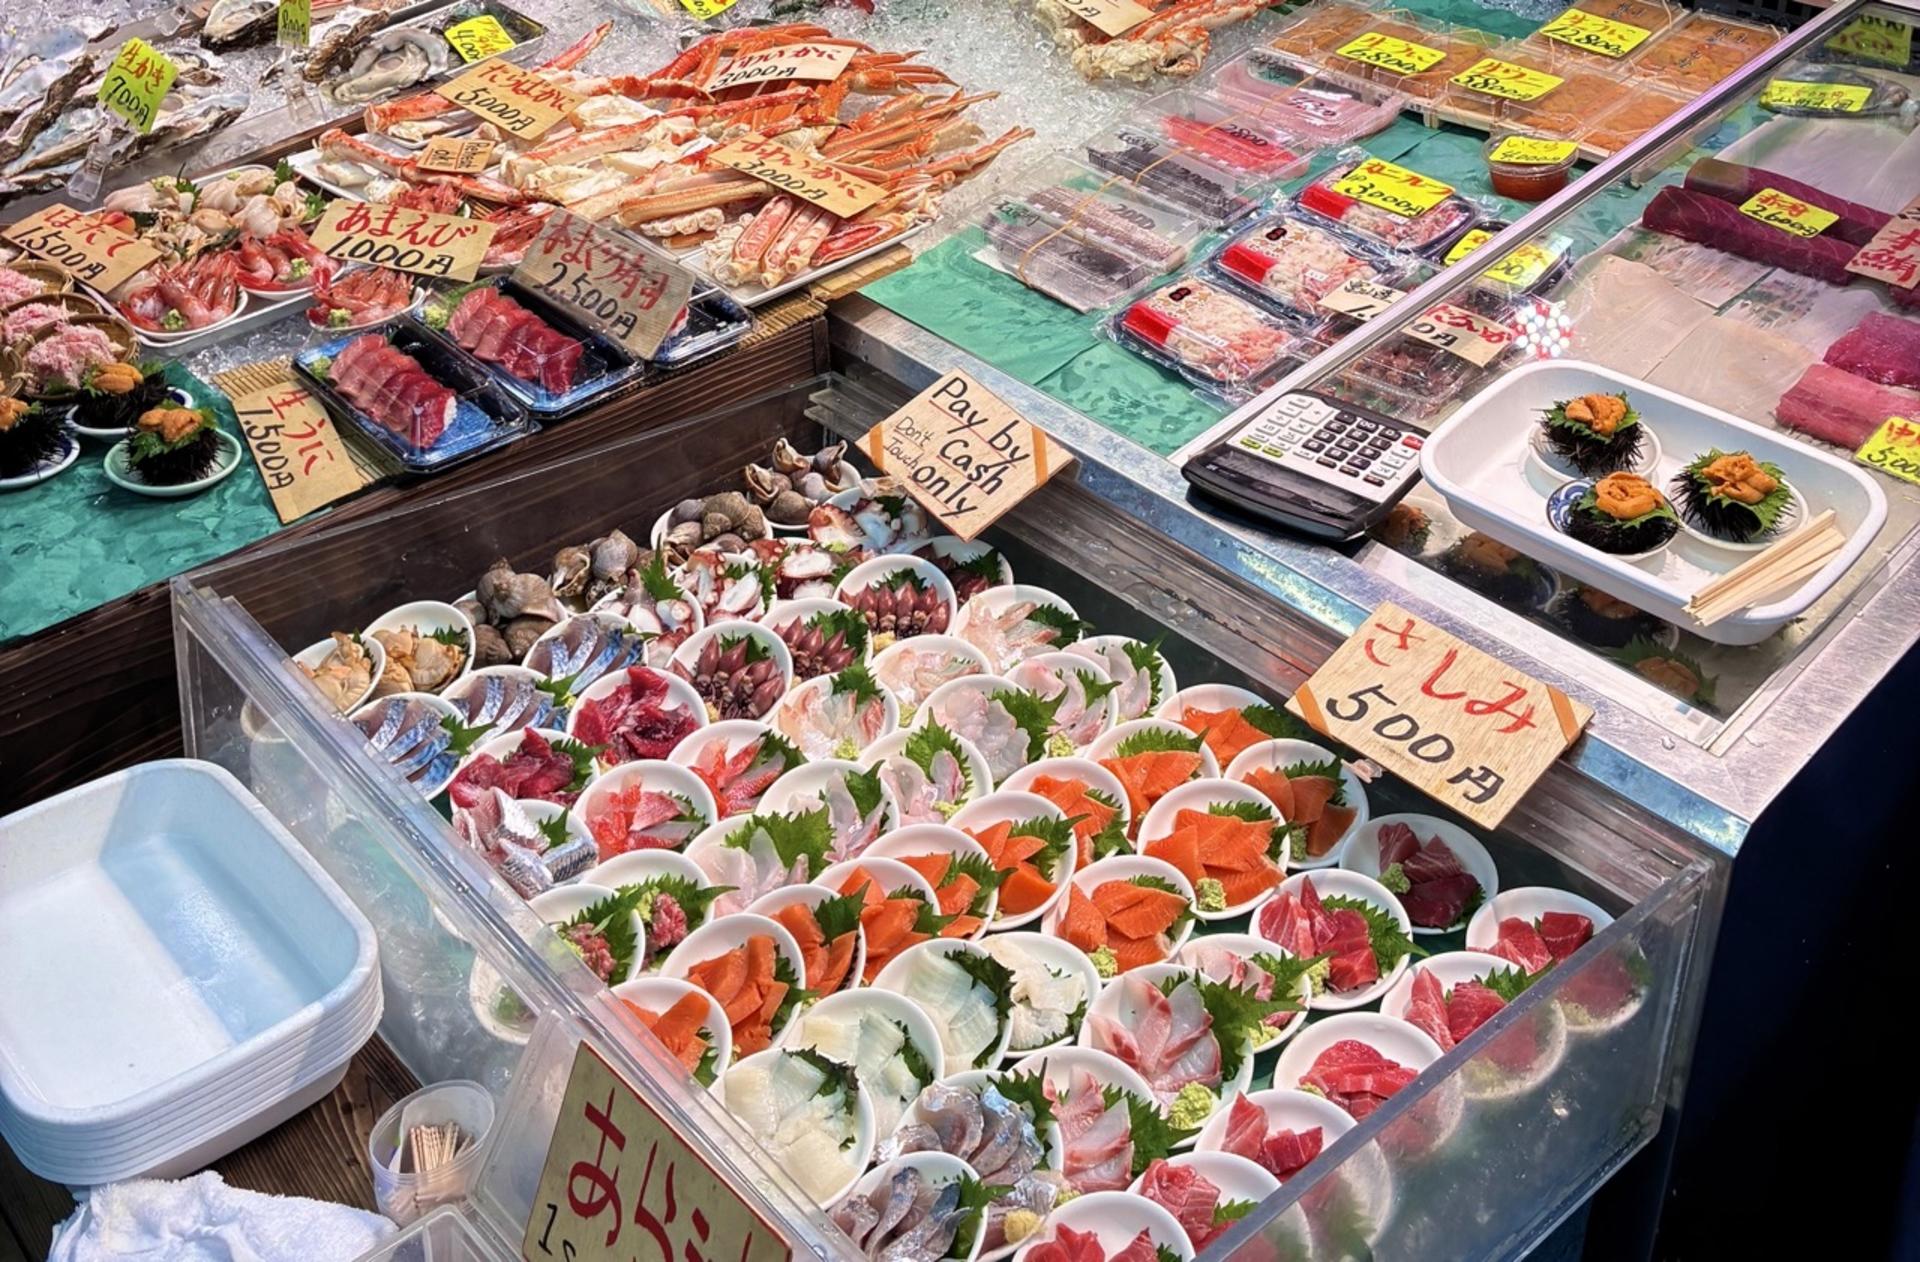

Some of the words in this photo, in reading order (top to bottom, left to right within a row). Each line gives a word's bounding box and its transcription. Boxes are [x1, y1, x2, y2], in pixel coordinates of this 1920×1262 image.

[116, 43, 165, 95] 生かき
[104, 75, 150, 126] 700円
[335, 202, 479, 248] あまえび
[267, 388, 335, 476] 生うに
[895, 416, 935, 448] Don't
[932, 376, 989, 434] Pay
[983, 420, 1030, 471] by
[912, 465, 978, 517] only
[939, 438, 1009, 495] Cash
[1365, 617, 1537, 734] さしみ
[1325, 683, 1505, 805] 500円
